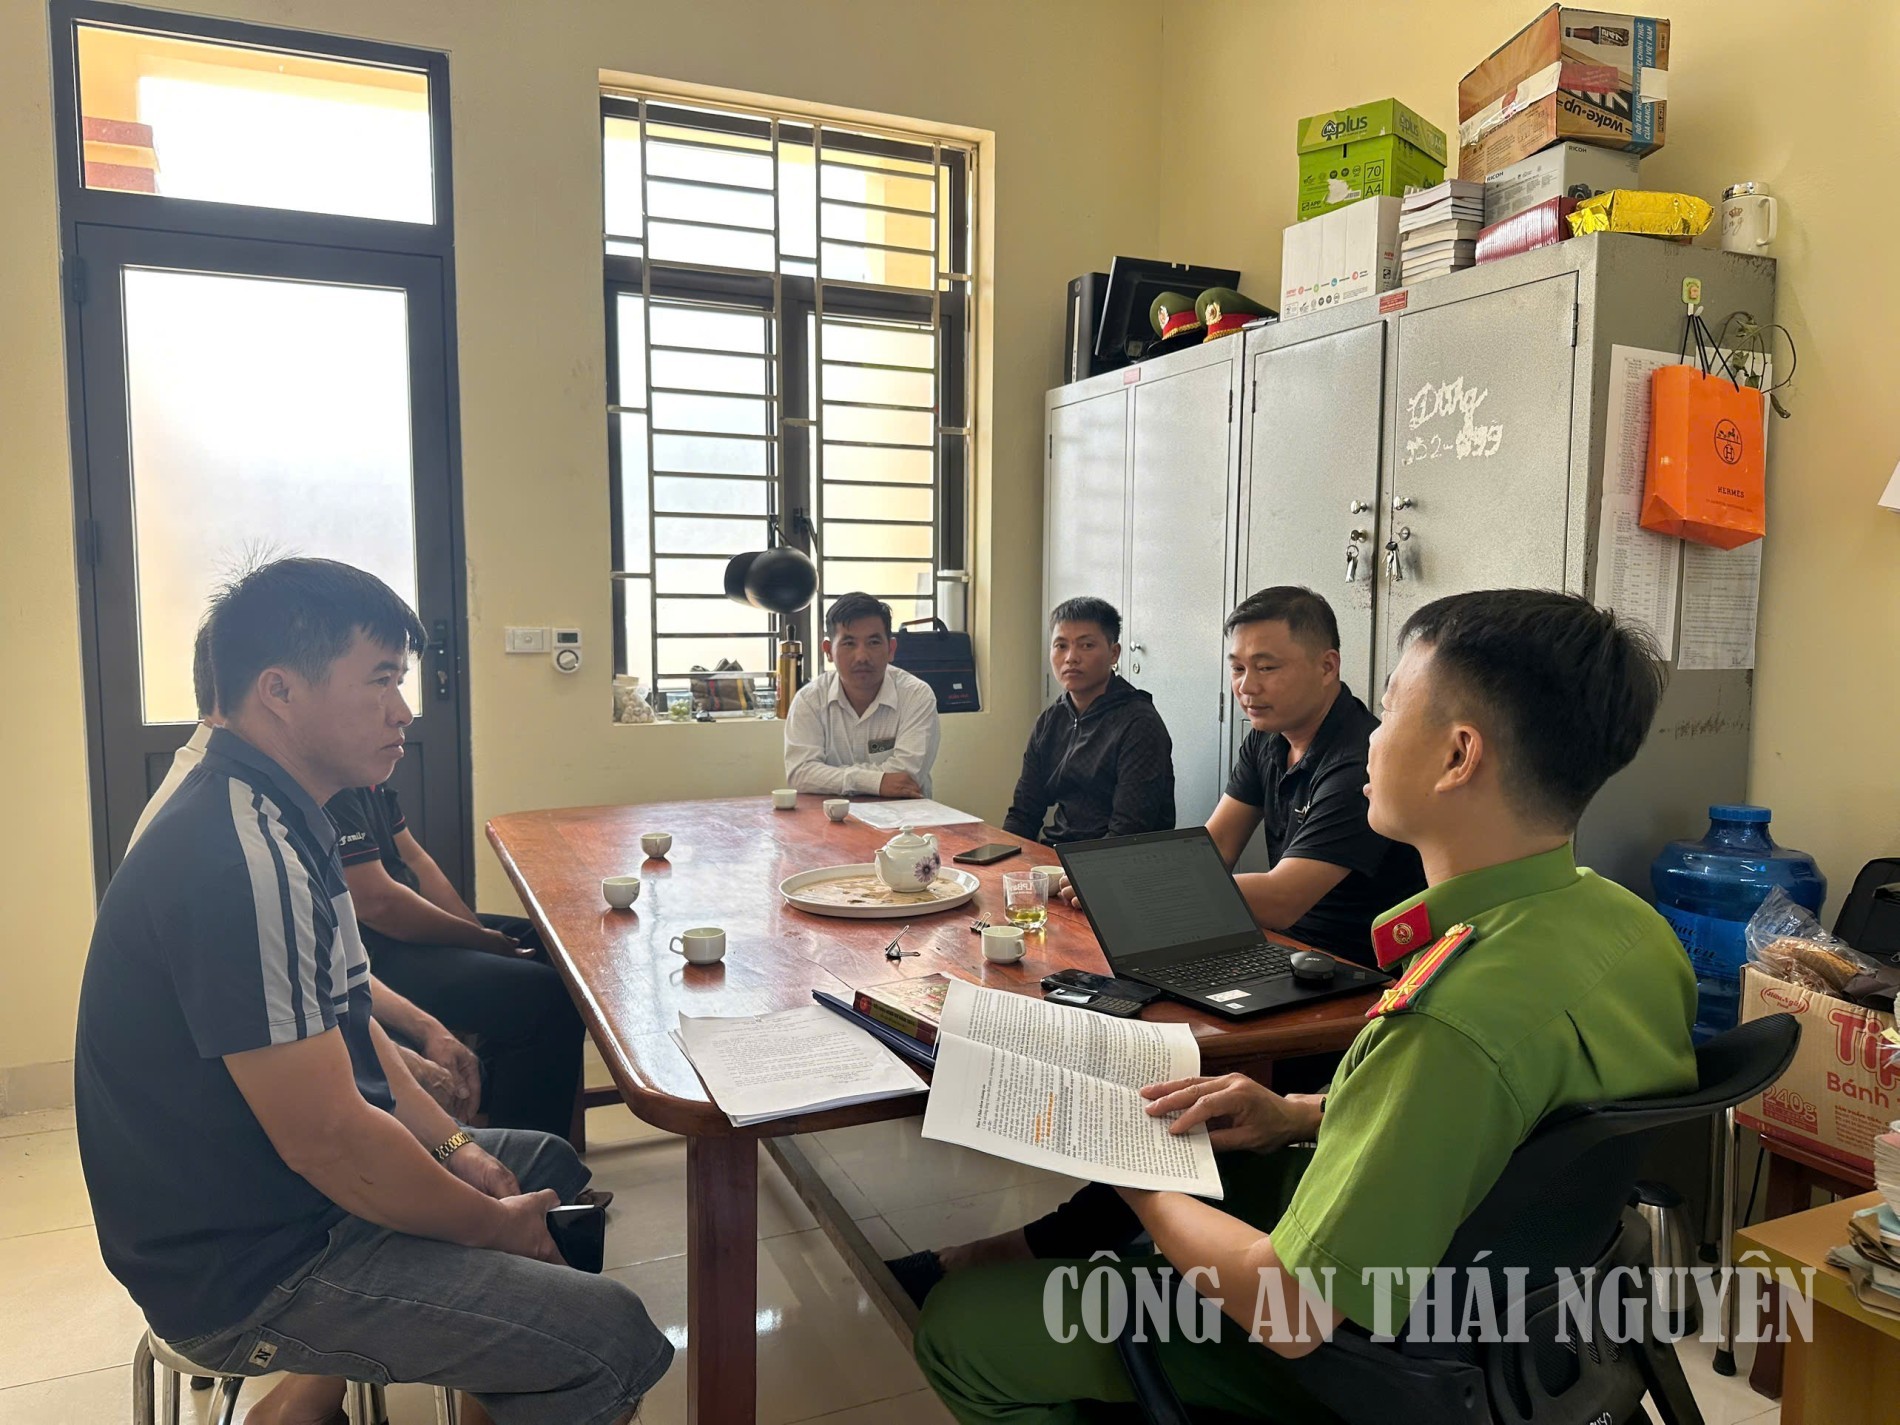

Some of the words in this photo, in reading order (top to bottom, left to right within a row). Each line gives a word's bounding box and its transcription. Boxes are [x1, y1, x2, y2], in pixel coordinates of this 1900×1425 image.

[1568, 145, 1587, 153] RICOH
[1367, 165, 1381, 179] 70
[1487, 171, 1504, 182] RICOH
[1365, 183, 1381, 197] A4
[1827, 1071, 1889, 1109] Bánh
[1763, 1084, 1817, 1123] 240g
